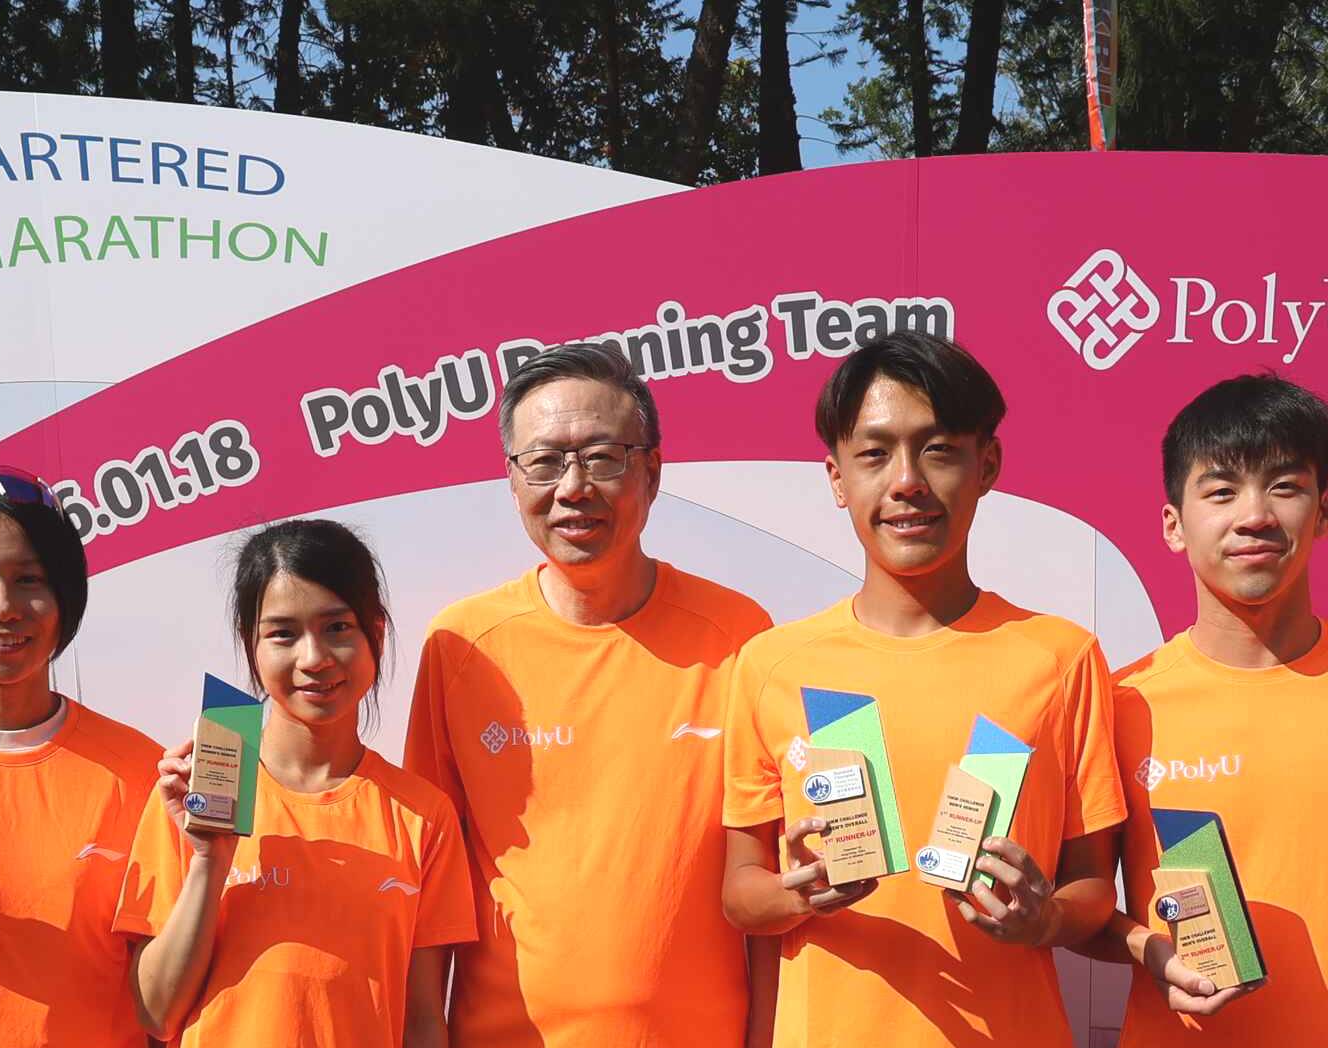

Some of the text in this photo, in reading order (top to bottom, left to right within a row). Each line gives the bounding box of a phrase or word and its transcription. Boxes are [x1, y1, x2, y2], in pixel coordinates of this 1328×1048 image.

[305, 354, 491, 452] PolyU
[501, 307, 767, 387] Rning
[777, 297, 949, 354] Team
[510, 725, 574, 753] PolyU
[1167, 754, 1242, 785] PolyU
[224, 865, 290, 891] PolyU
